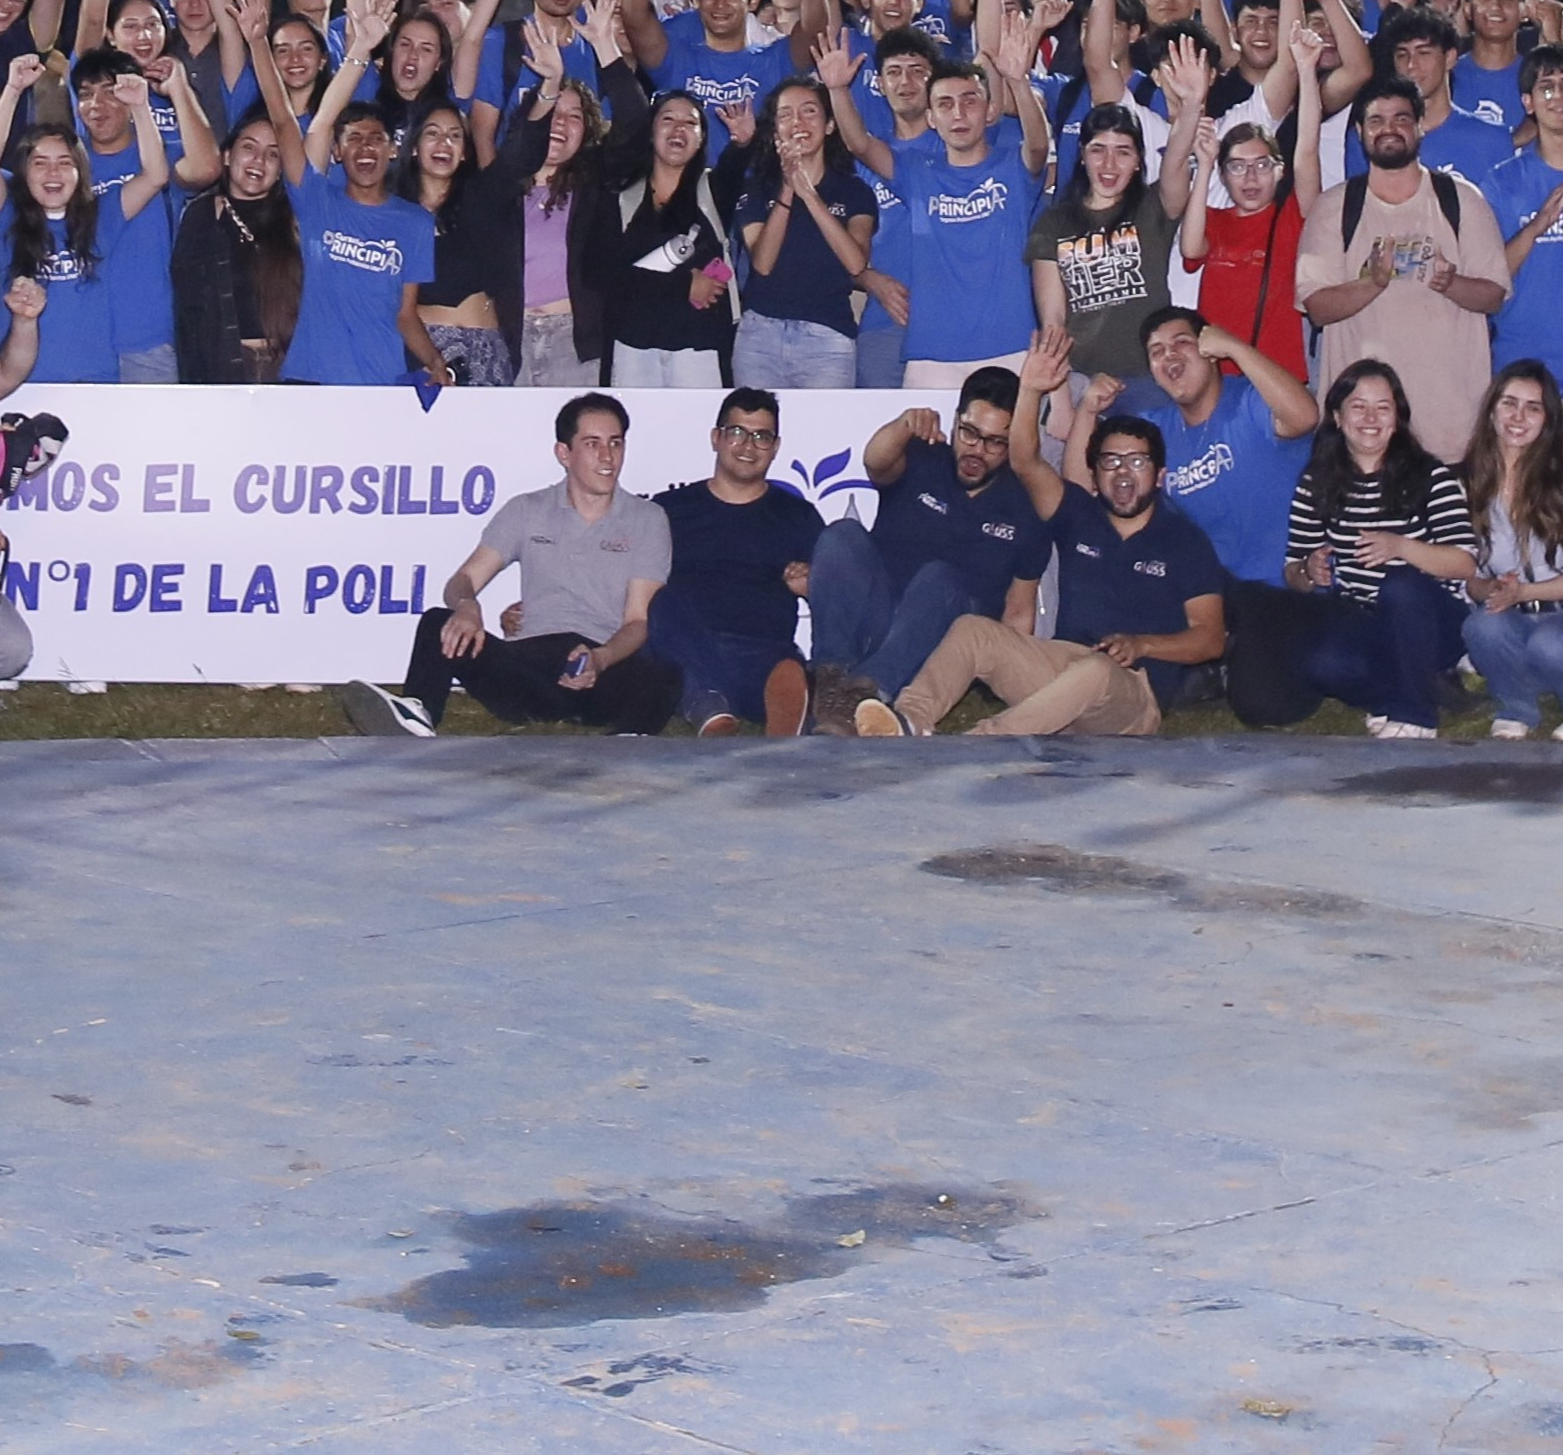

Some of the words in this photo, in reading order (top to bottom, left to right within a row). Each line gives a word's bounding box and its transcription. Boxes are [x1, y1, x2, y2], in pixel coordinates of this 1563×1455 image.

[928, 185, 1008, 216] PRINCIPIA
[323, 232, 403, 275] PRINCIPIA
[1057, 226, 1141, 266] SUM
[143, 464, 210, 513] EL
[233, 464, 495, 515] CURSILLO
[6, 560, 91, 611] N°1
[113, 563, 185, 612] DE
[207, 564, 279, 613] LA
[303, 564, 426, 614] POLI
